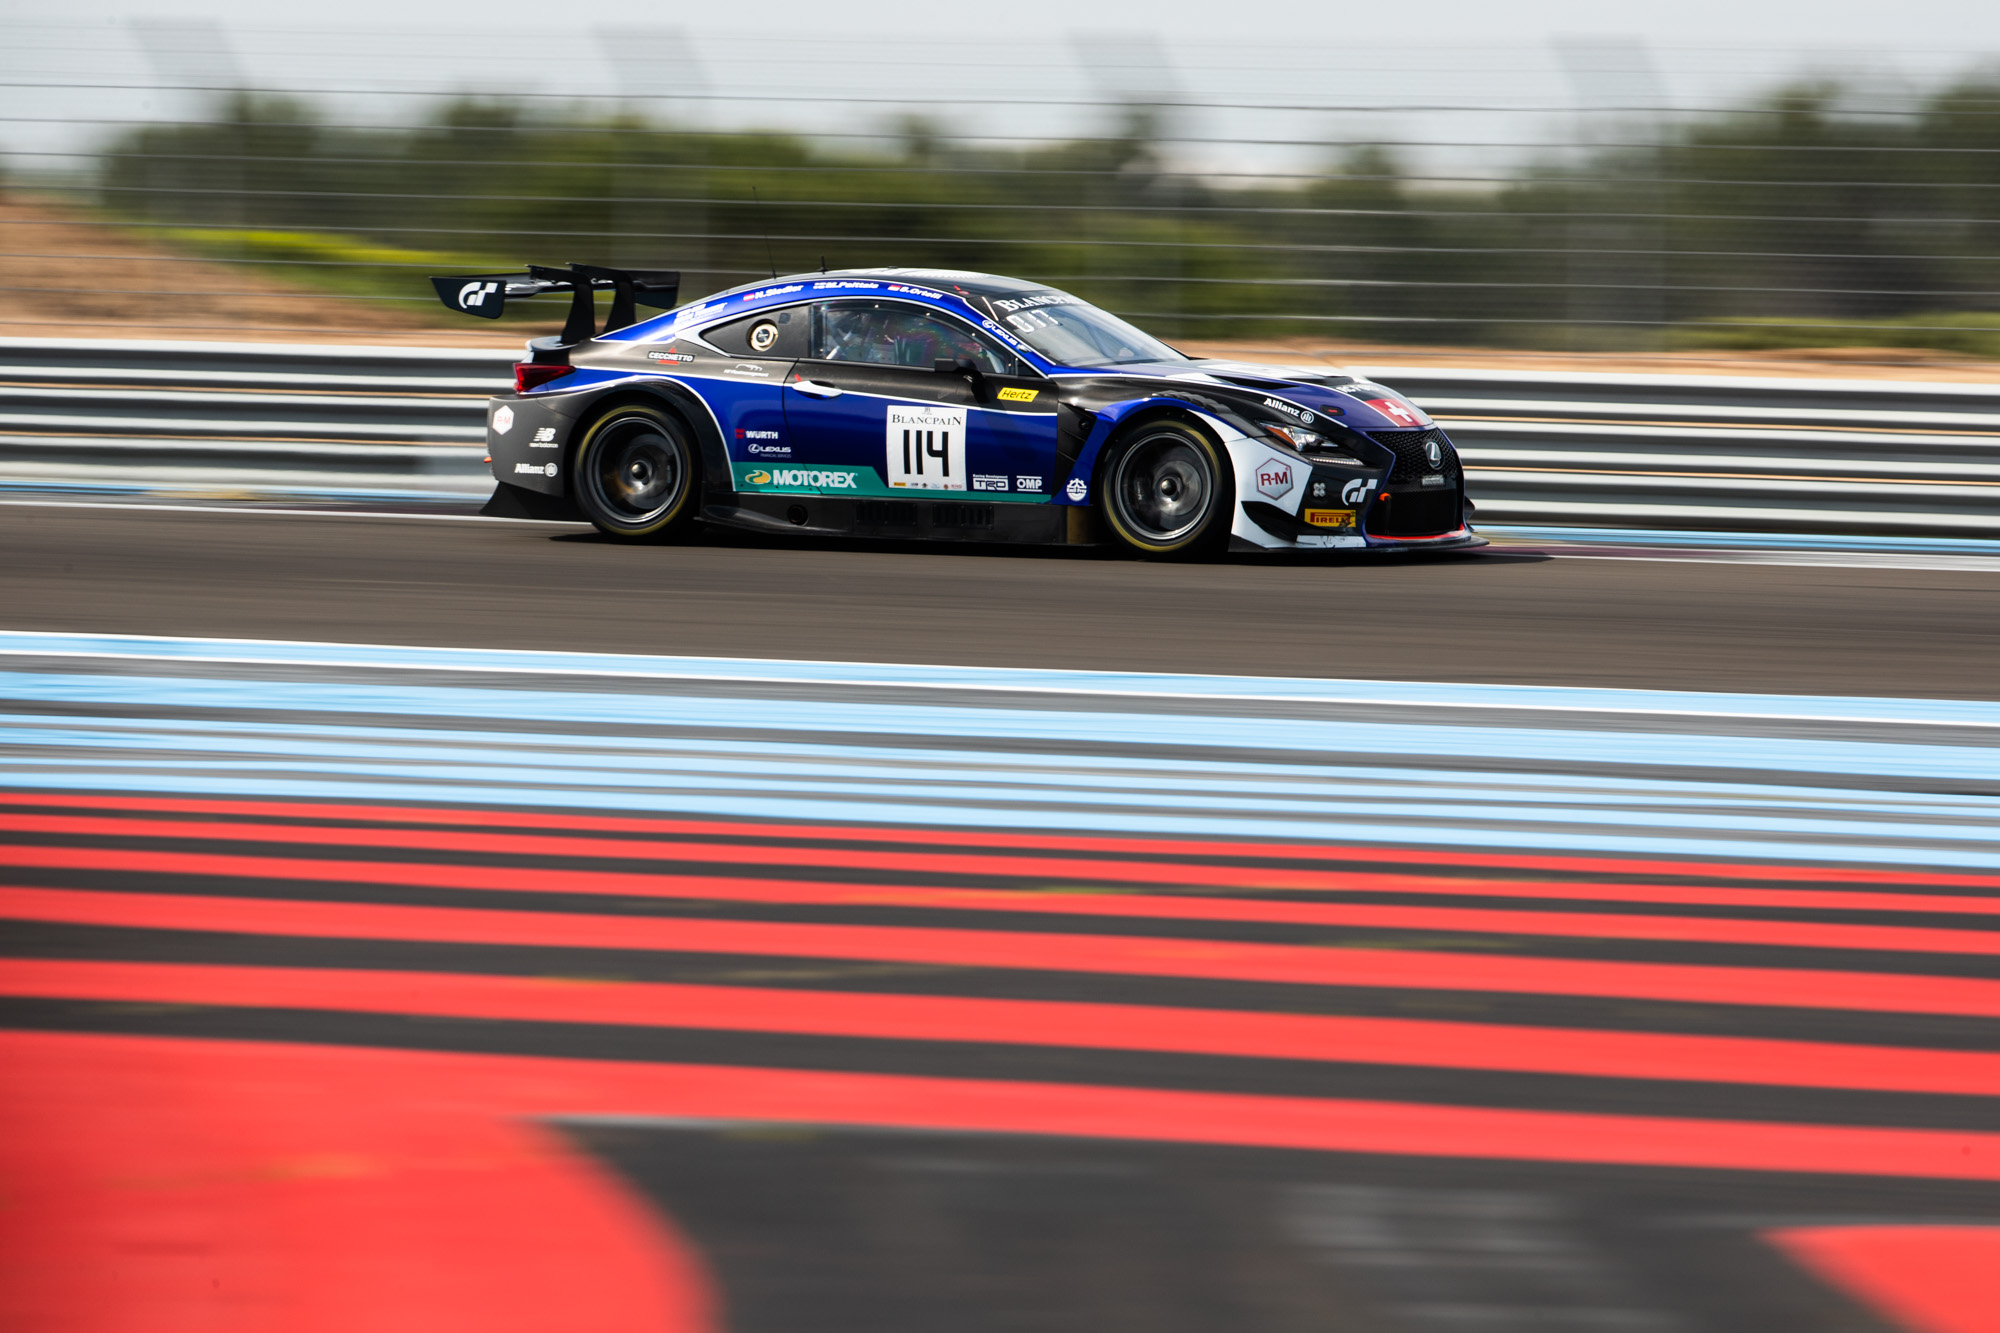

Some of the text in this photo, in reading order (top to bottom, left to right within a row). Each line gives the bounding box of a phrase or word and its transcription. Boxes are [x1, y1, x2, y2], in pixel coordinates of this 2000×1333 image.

[648, 352, 693, 362] CECCHETTO
[1002, 390, 1032, 400] Hertz
[1263, 397, 1300, 417] Allianz
[892, 414, 962, 426] BLANCPAIN
[903, 429, 950, 478] 114
[514, 463, 545, 474] Allianz
[772, 469, 858, 489] MOTOREX
[1016, 478, 1042, 490] OMP
[1260, 471, 1289, 486] R-M
